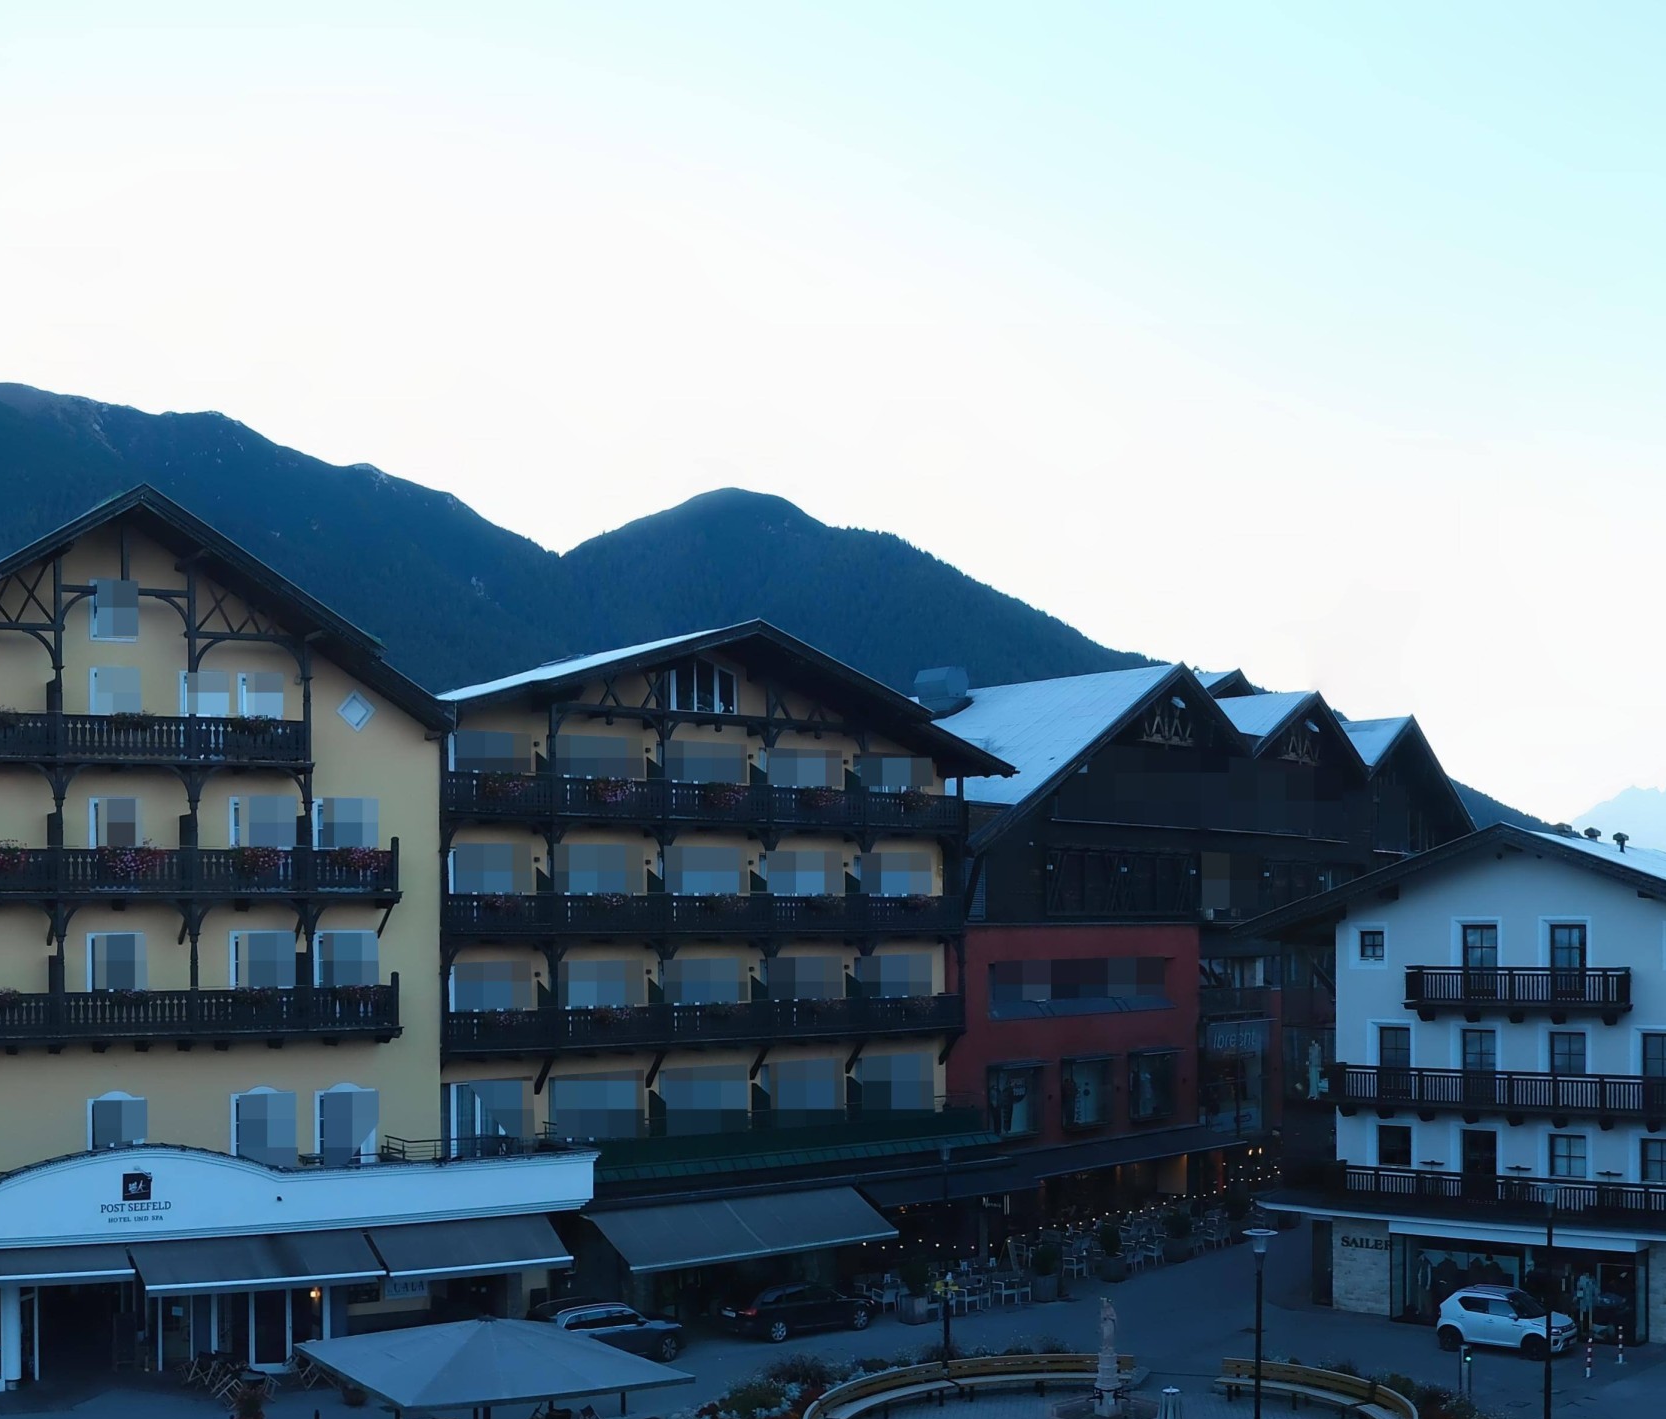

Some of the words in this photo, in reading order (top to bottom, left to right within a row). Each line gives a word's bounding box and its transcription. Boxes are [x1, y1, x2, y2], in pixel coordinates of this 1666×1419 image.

[100, 1203, 125, 1213] POST
[128, 1201, 172, 1212] SEEFELD
[1341, 1236, 1393, 1251] SAILER
